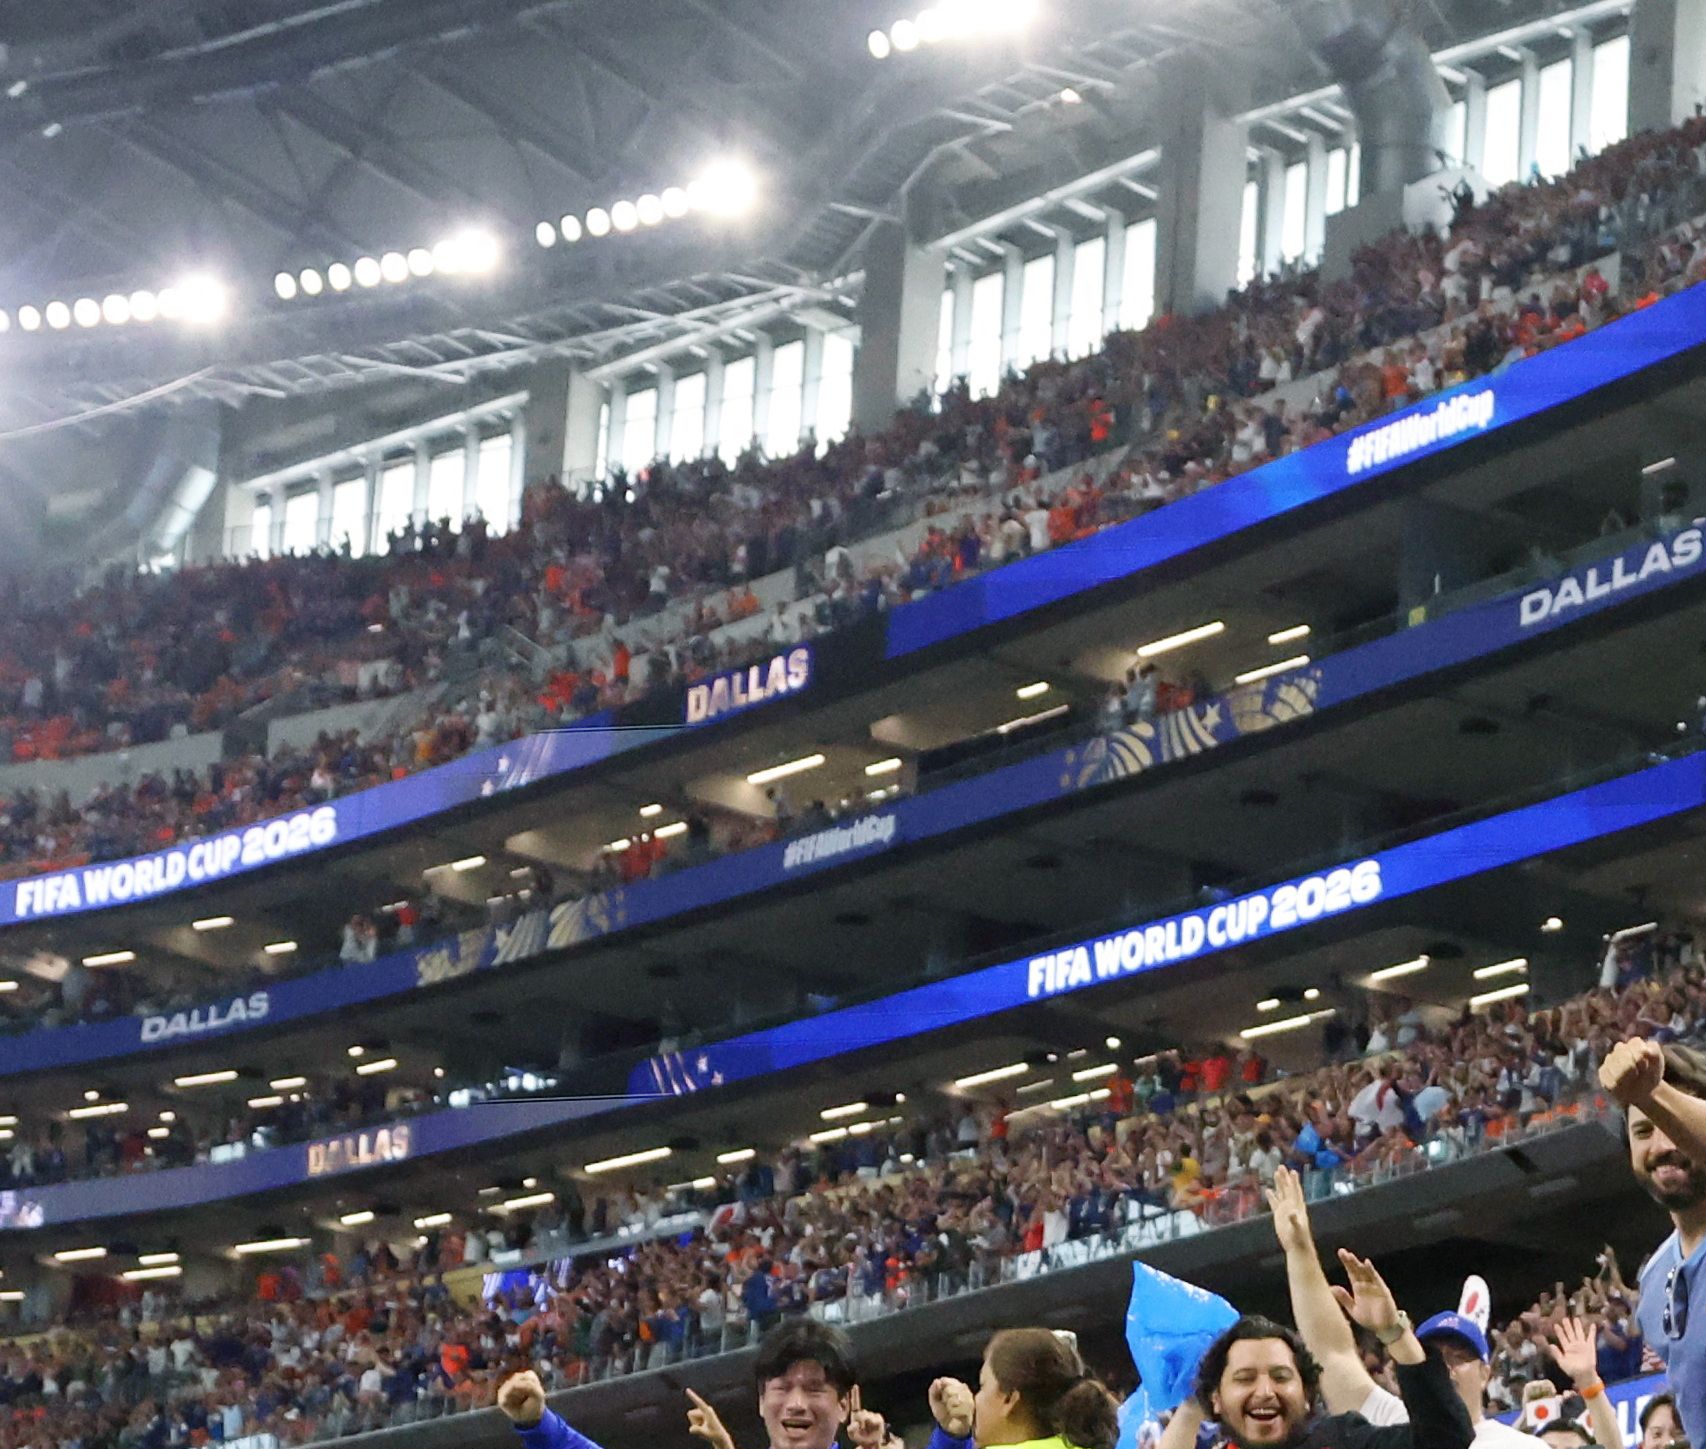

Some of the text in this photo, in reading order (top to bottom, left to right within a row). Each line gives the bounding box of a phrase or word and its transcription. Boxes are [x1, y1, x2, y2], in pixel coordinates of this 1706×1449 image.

[1519, 528, 1703, 626] DALLAS
[686, 648, 810, 723] DALLAS
[15, 806, 337, 917] FIFA WORLD CUP 2026
[1027, 860, 1383, 998] FIFA WORLD CUP 2026
[141, 991, 270, 1043] DALLAS
[308, 1125, 411, 1177] DALLAS
